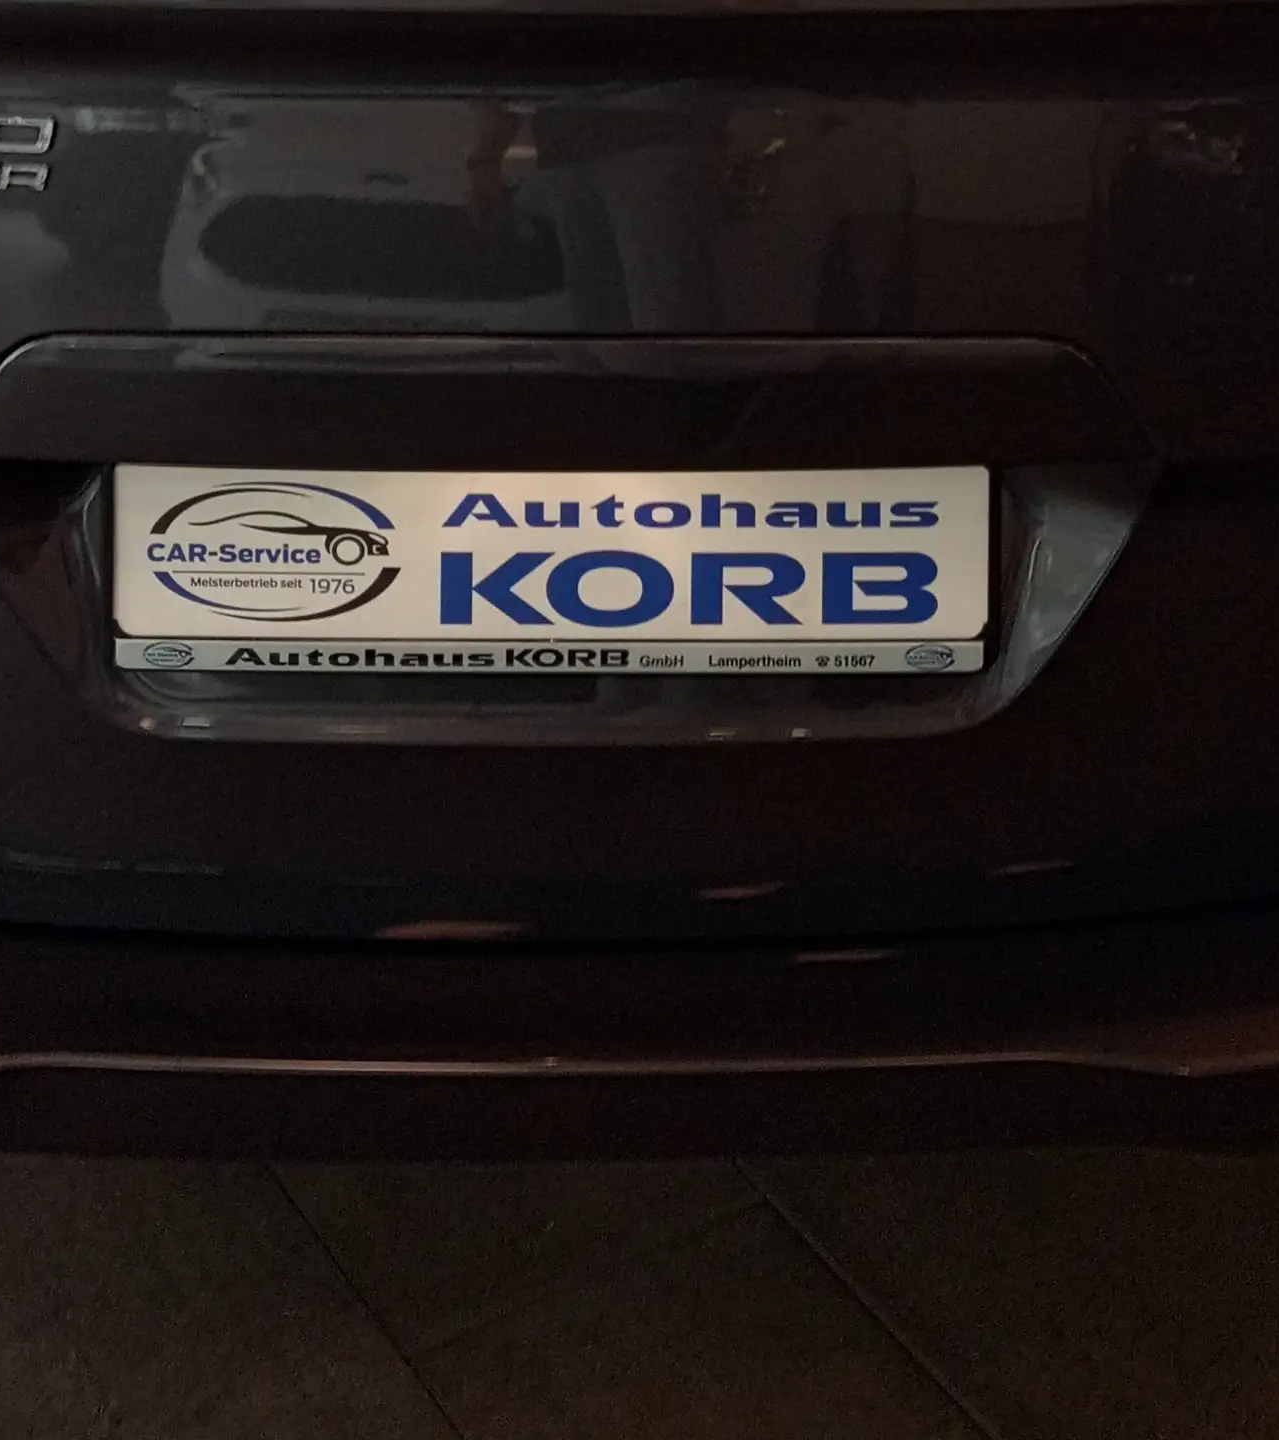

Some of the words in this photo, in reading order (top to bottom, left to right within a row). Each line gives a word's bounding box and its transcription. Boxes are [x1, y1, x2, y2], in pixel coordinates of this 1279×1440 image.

[441, 493, 940, 529] Autohaus
[147, 542, 322, 564] CAR-Service
[190, 576, 278, 589] Meisterbetrieb
[280, 578, 303, 589] seit
[310, 578, 356, 595] 1976
[439, 549, 939, 628] KORB
[225, 647, 495, 668] Autohaus
[505, 648, 630, 668] KORB
[639, 654, 685, 669] GmbH
[708, 654, 802, 669] Lampertheim
